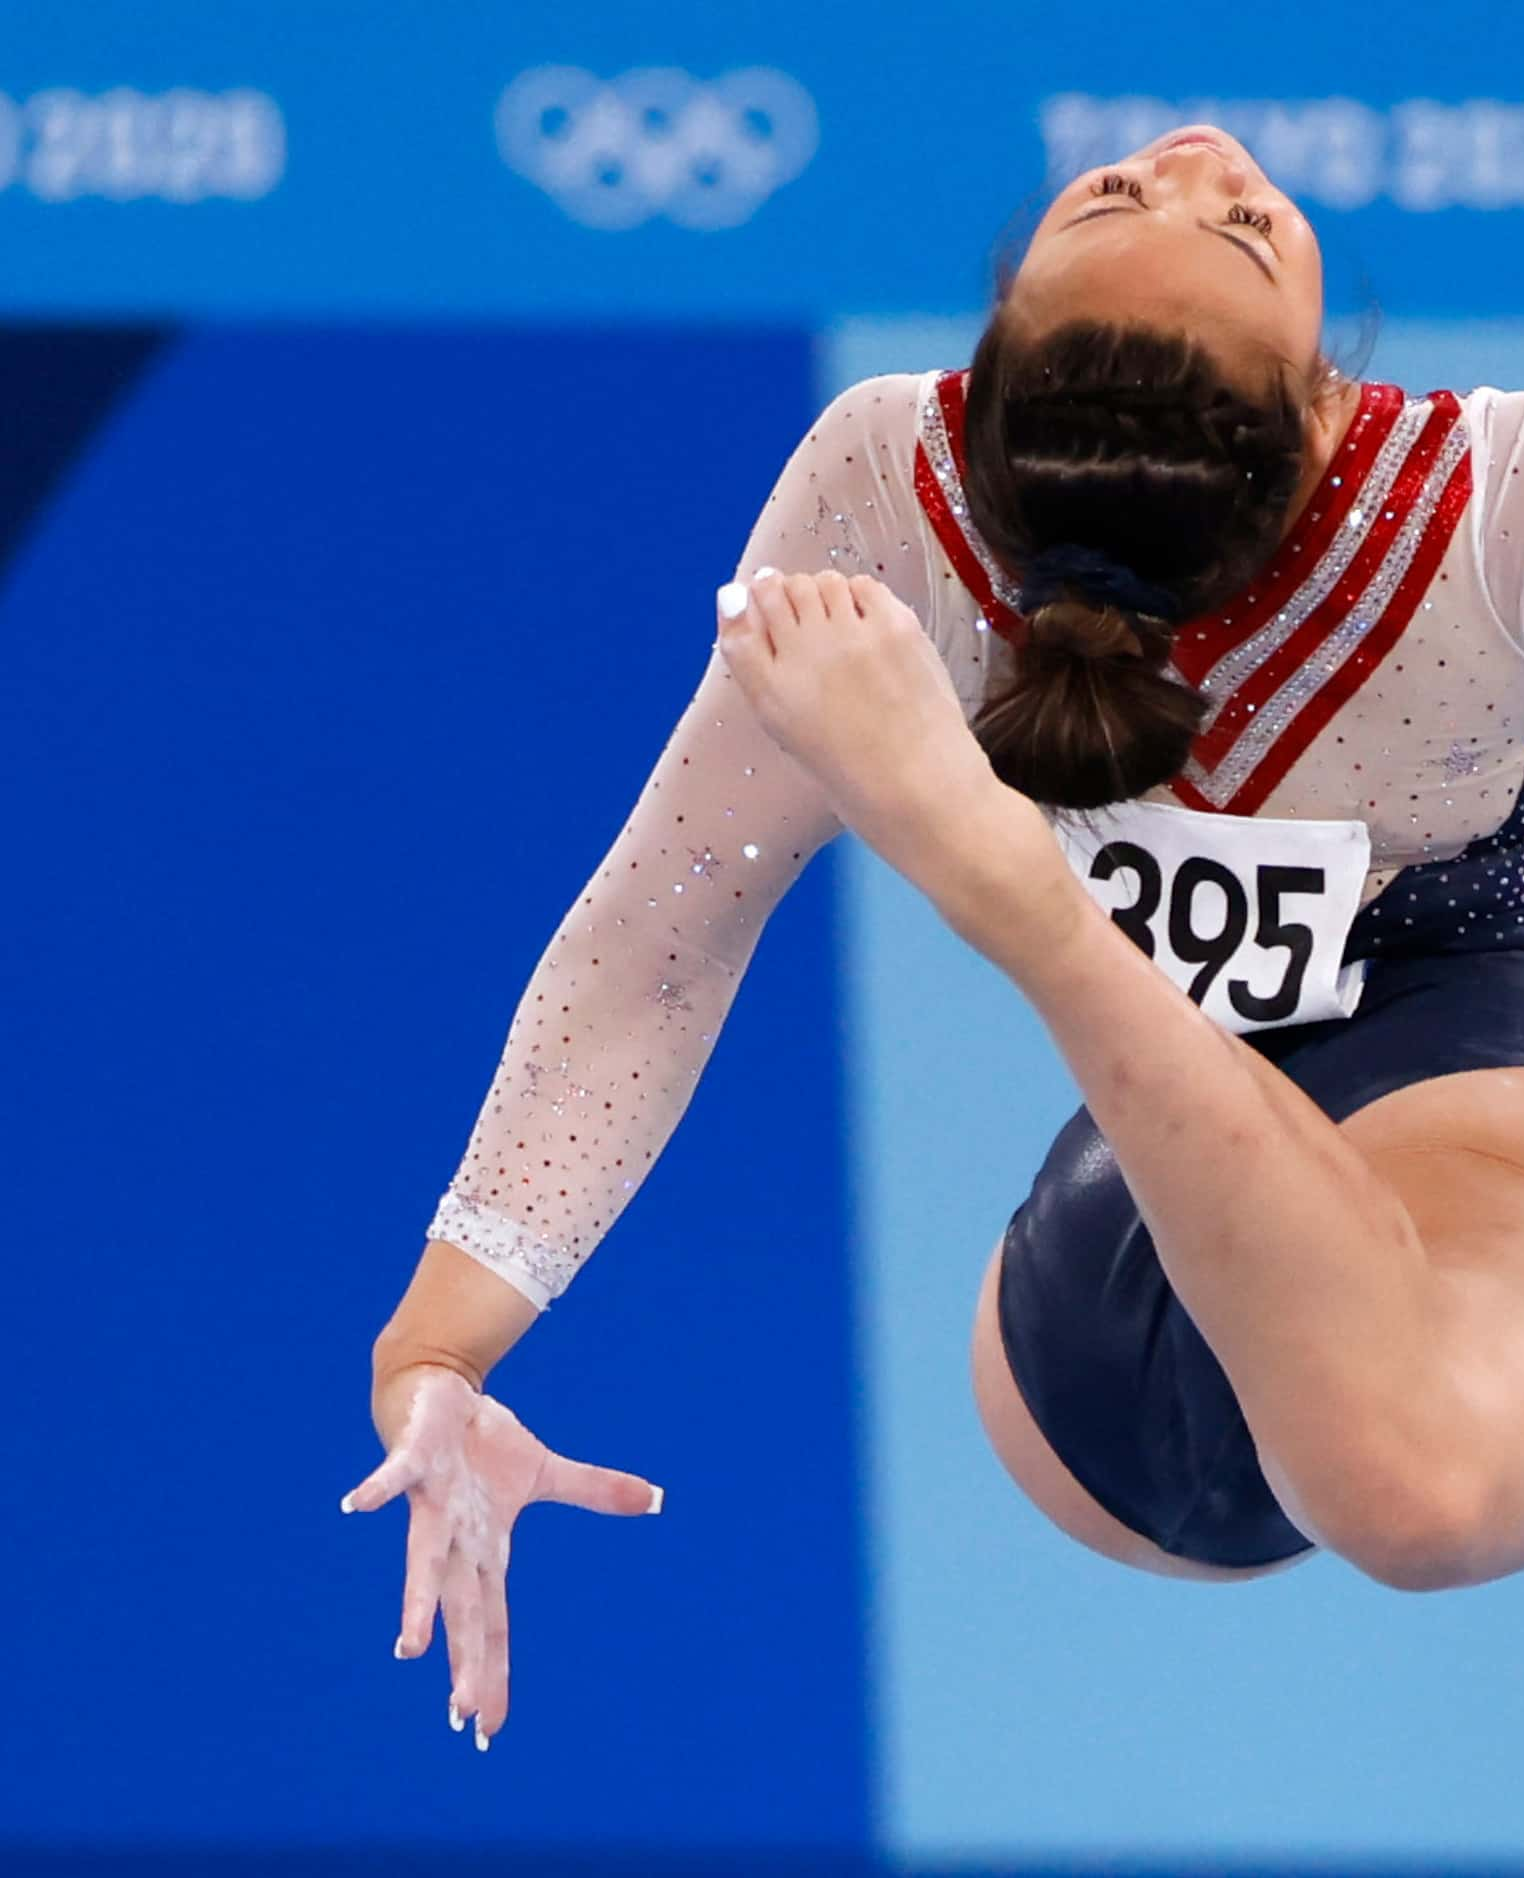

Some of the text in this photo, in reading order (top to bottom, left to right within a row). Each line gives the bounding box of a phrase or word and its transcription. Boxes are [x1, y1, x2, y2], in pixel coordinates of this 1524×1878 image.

[24, 88, 286, 201] 2020
[1042, 95, 1384, 208] TYO
[1089, 841, 1325, 1022] 395
